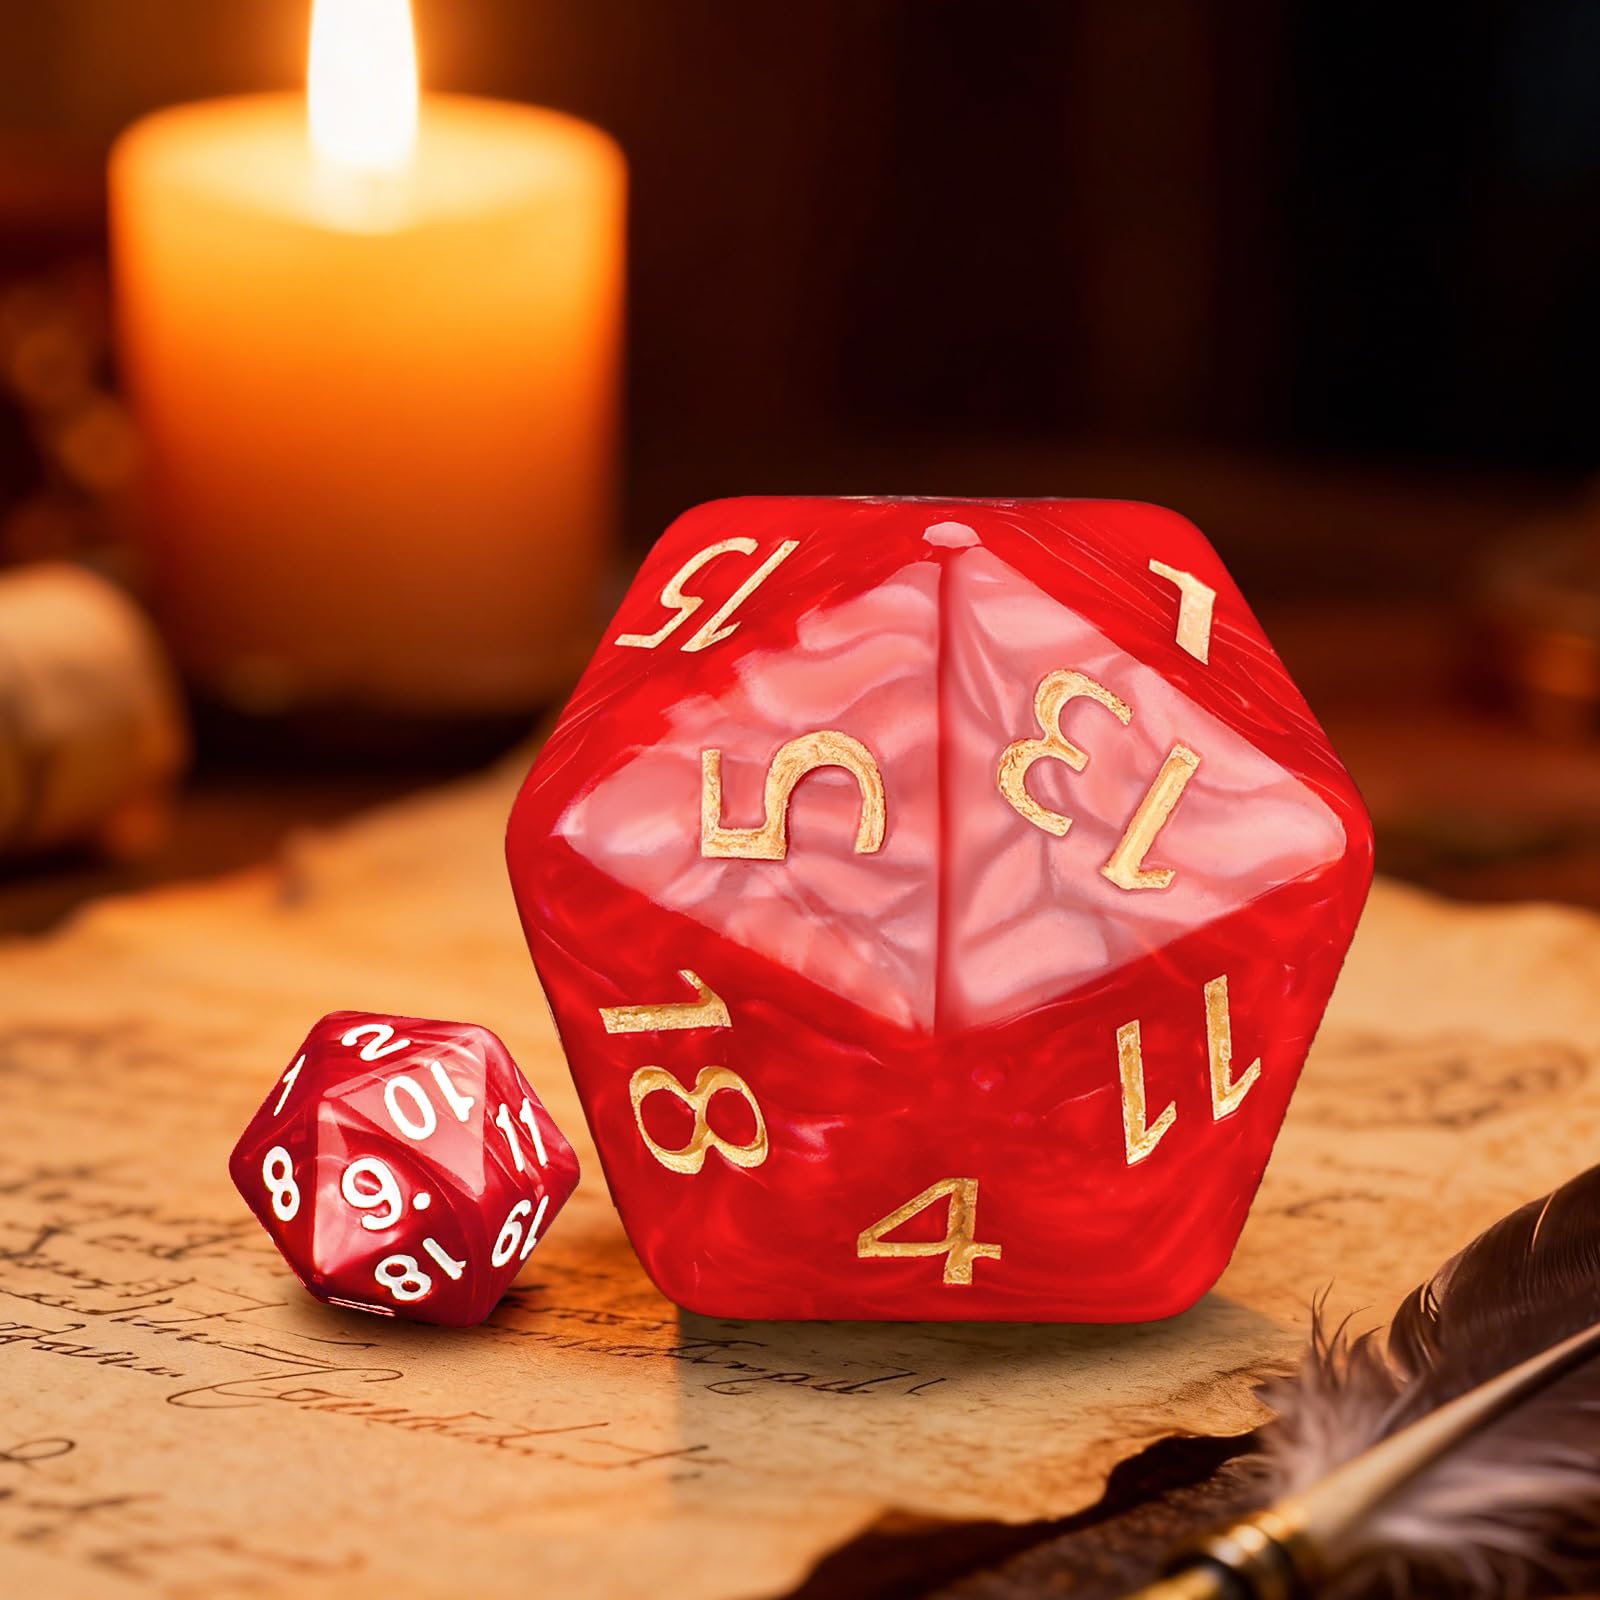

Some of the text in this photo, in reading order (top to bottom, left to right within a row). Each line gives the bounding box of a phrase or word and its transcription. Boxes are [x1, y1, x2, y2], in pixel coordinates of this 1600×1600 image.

[615, 538, 799, 652] 15
[700, 730, 887, 861] 5
[998, 669, 1201, 890] 13
[273, 1054, 306, 1116] 1
[341, 1023, 410, 1061] 2
[598, 969, 769, 1175] 18
[1116, 974, 1263, 1165] 11
[383, 1060, 474, 1140] 10
[496, 1098, 547, 1172] 11
[262, 1146, 300, 1222] 8
[374, 1237, 466, 1301] 18
[857, 1178, 1001, 1285] 4
